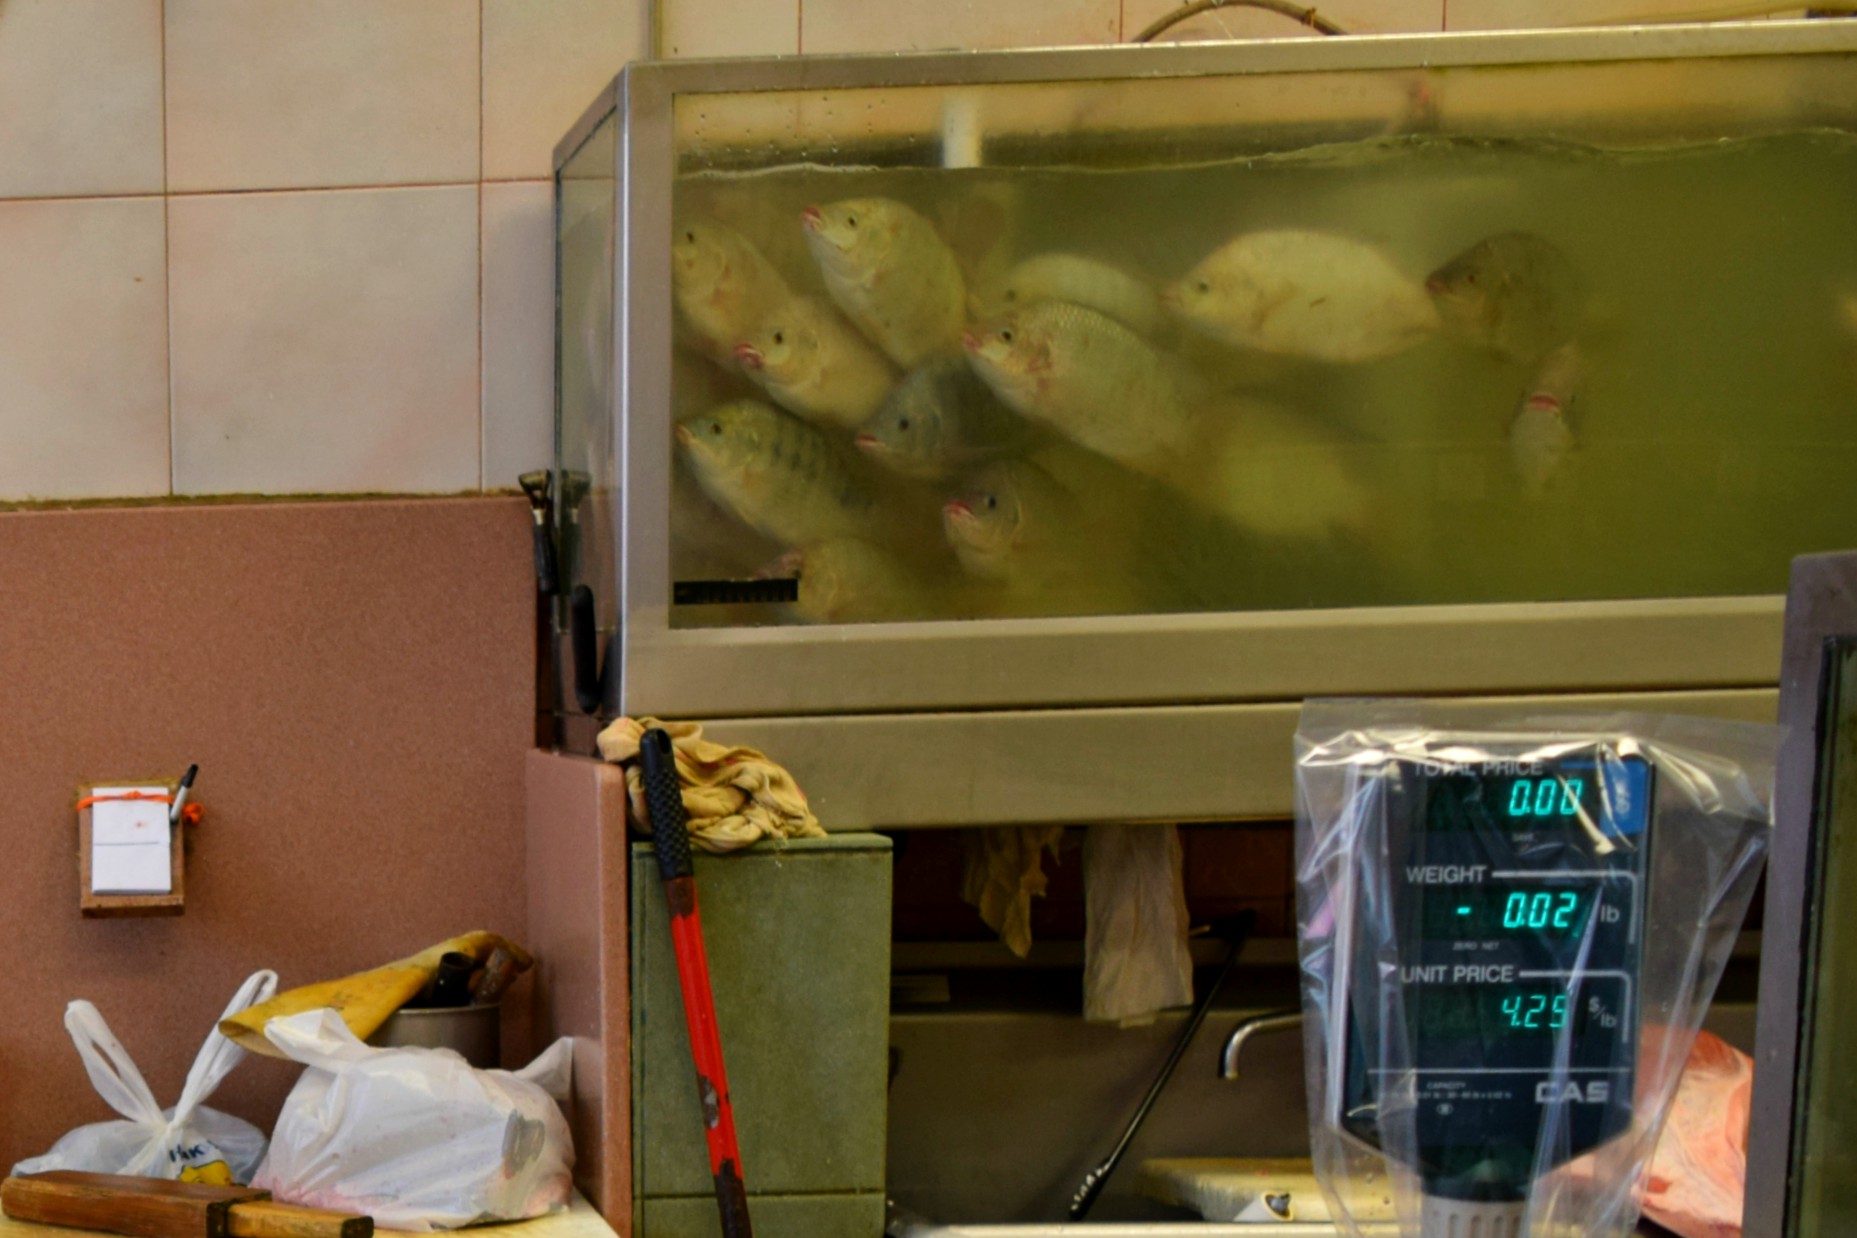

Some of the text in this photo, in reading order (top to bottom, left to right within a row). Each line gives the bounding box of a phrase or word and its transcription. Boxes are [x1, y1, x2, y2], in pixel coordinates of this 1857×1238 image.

[1482, 760, 1544, 777] PRICE
[1406, 865, 1487, 884] WEIGHT
[1502, 892, 1578, 929] 0.02
[1400, 965, 1515, 984] UNIT PRICE
[1535, 1081, 1610, 1104] CAS
